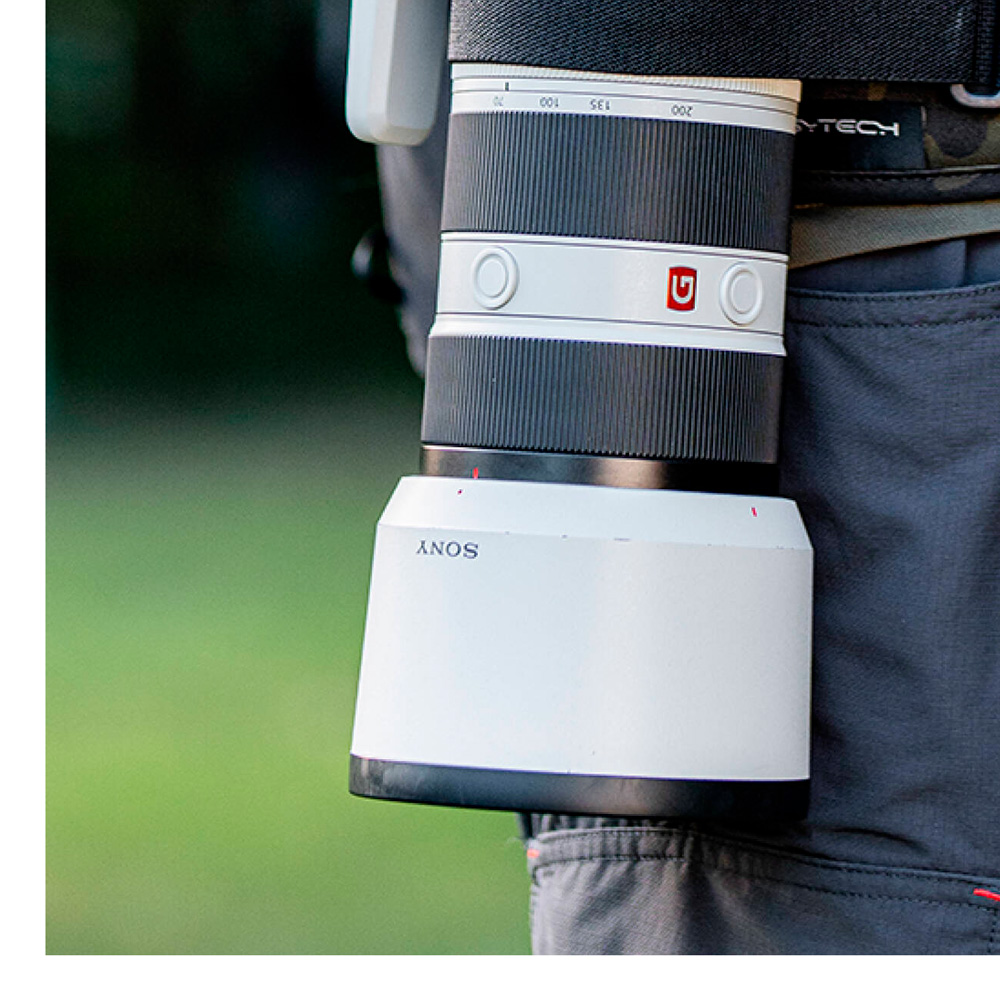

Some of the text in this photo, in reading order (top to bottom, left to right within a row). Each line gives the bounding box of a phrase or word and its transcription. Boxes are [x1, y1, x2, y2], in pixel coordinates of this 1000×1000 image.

[492, 96, 694, 118] 200 135 100 70
[415, 539, 479, 560] SONY
